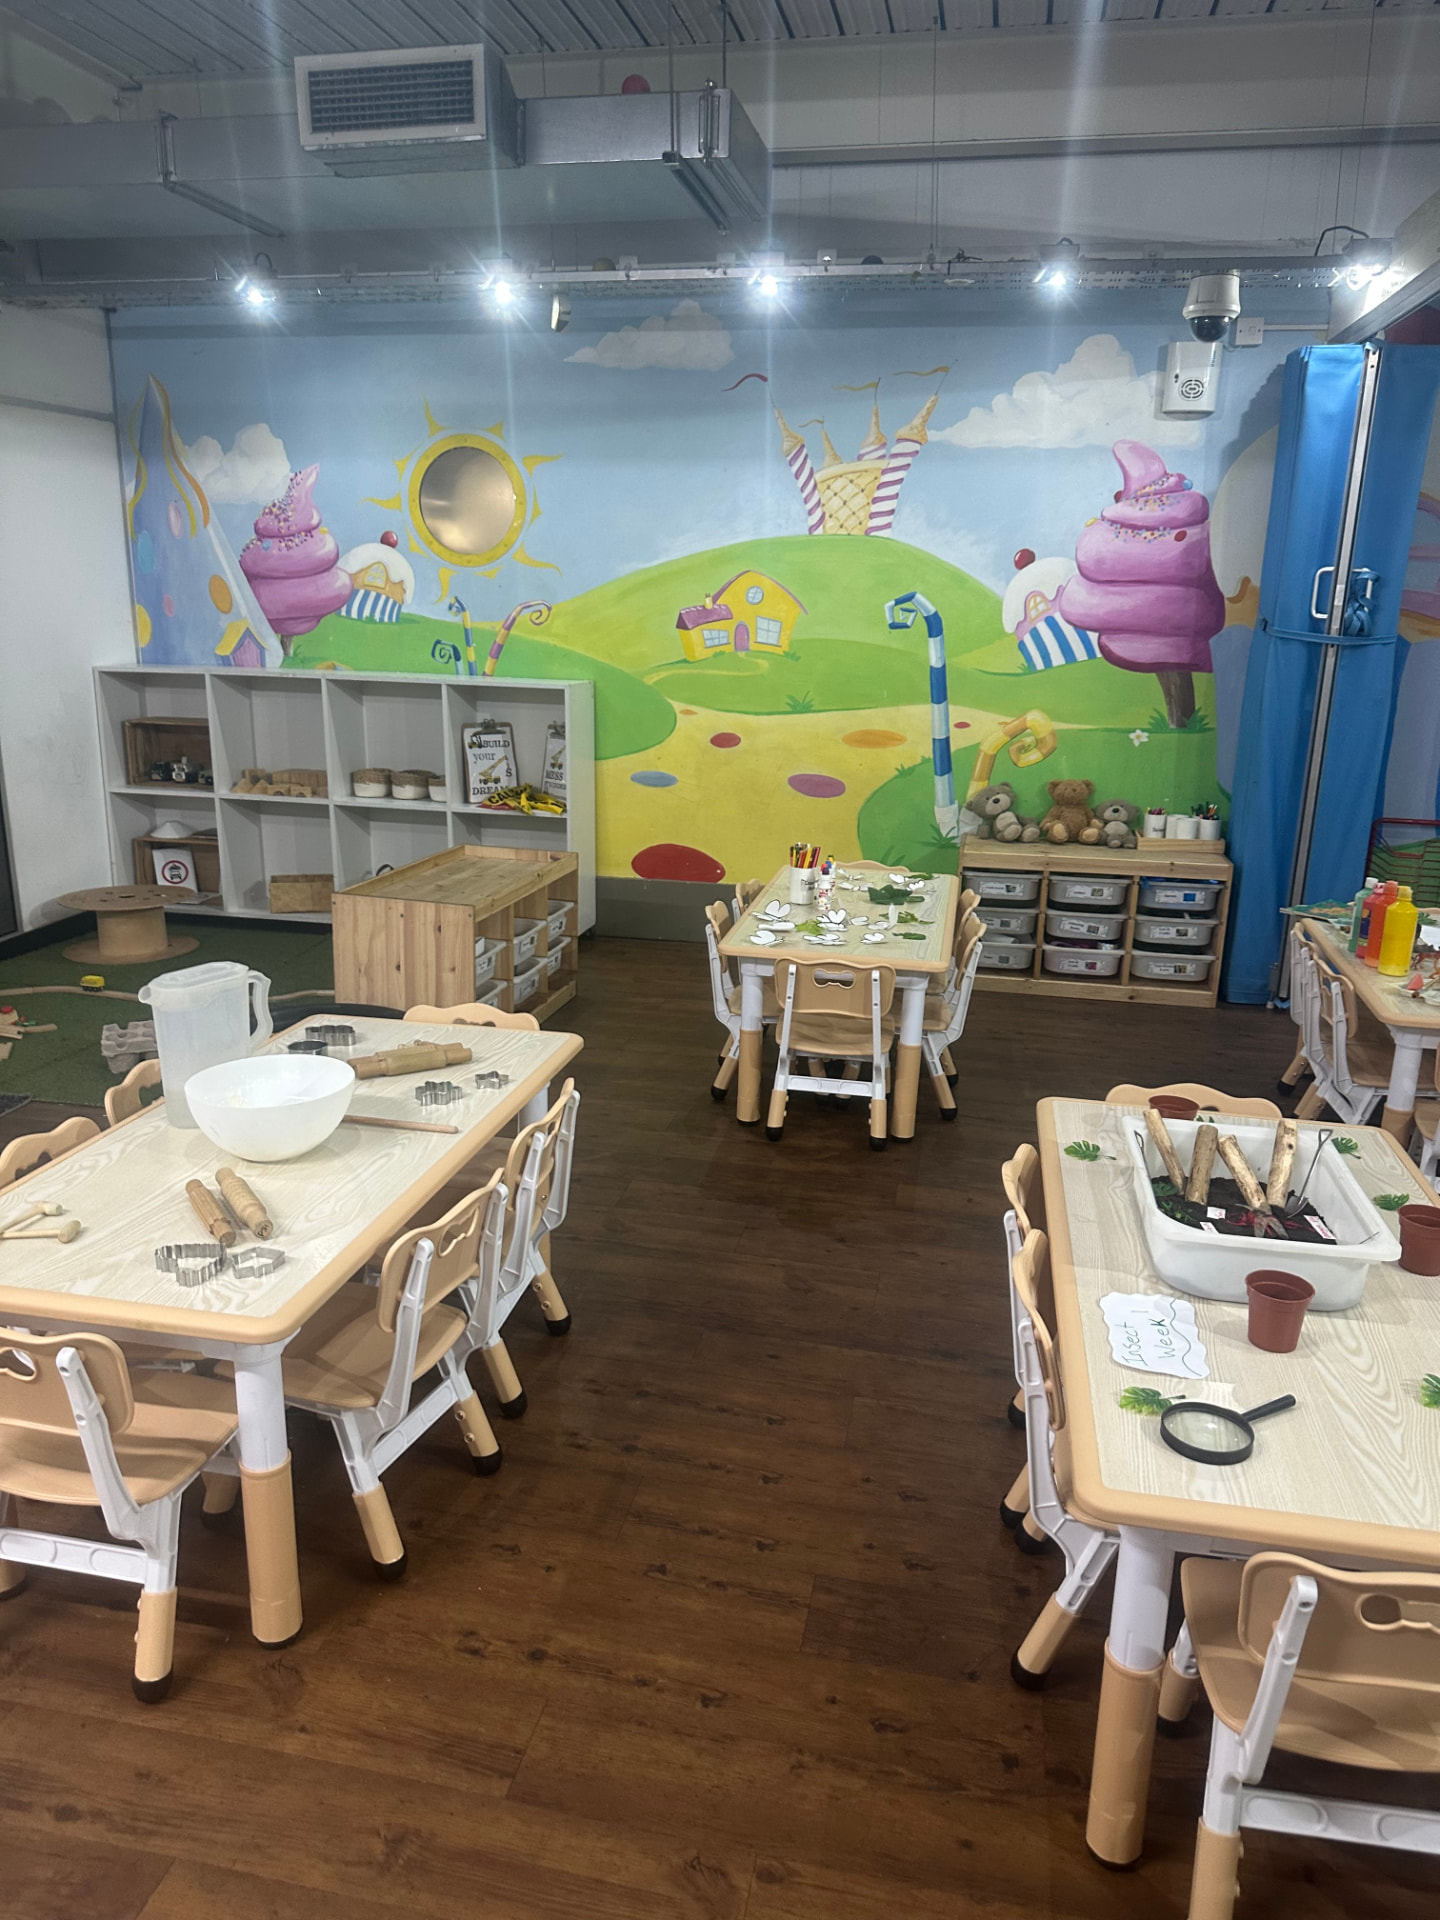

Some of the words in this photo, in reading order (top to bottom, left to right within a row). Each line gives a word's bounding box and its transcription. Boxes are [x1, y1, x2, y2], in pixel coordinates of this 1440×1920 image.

[483, 740, 510, 748] BUILD
[473, 753, 496, 764] your
[1114, 1321, 1148, 1366] Insect
